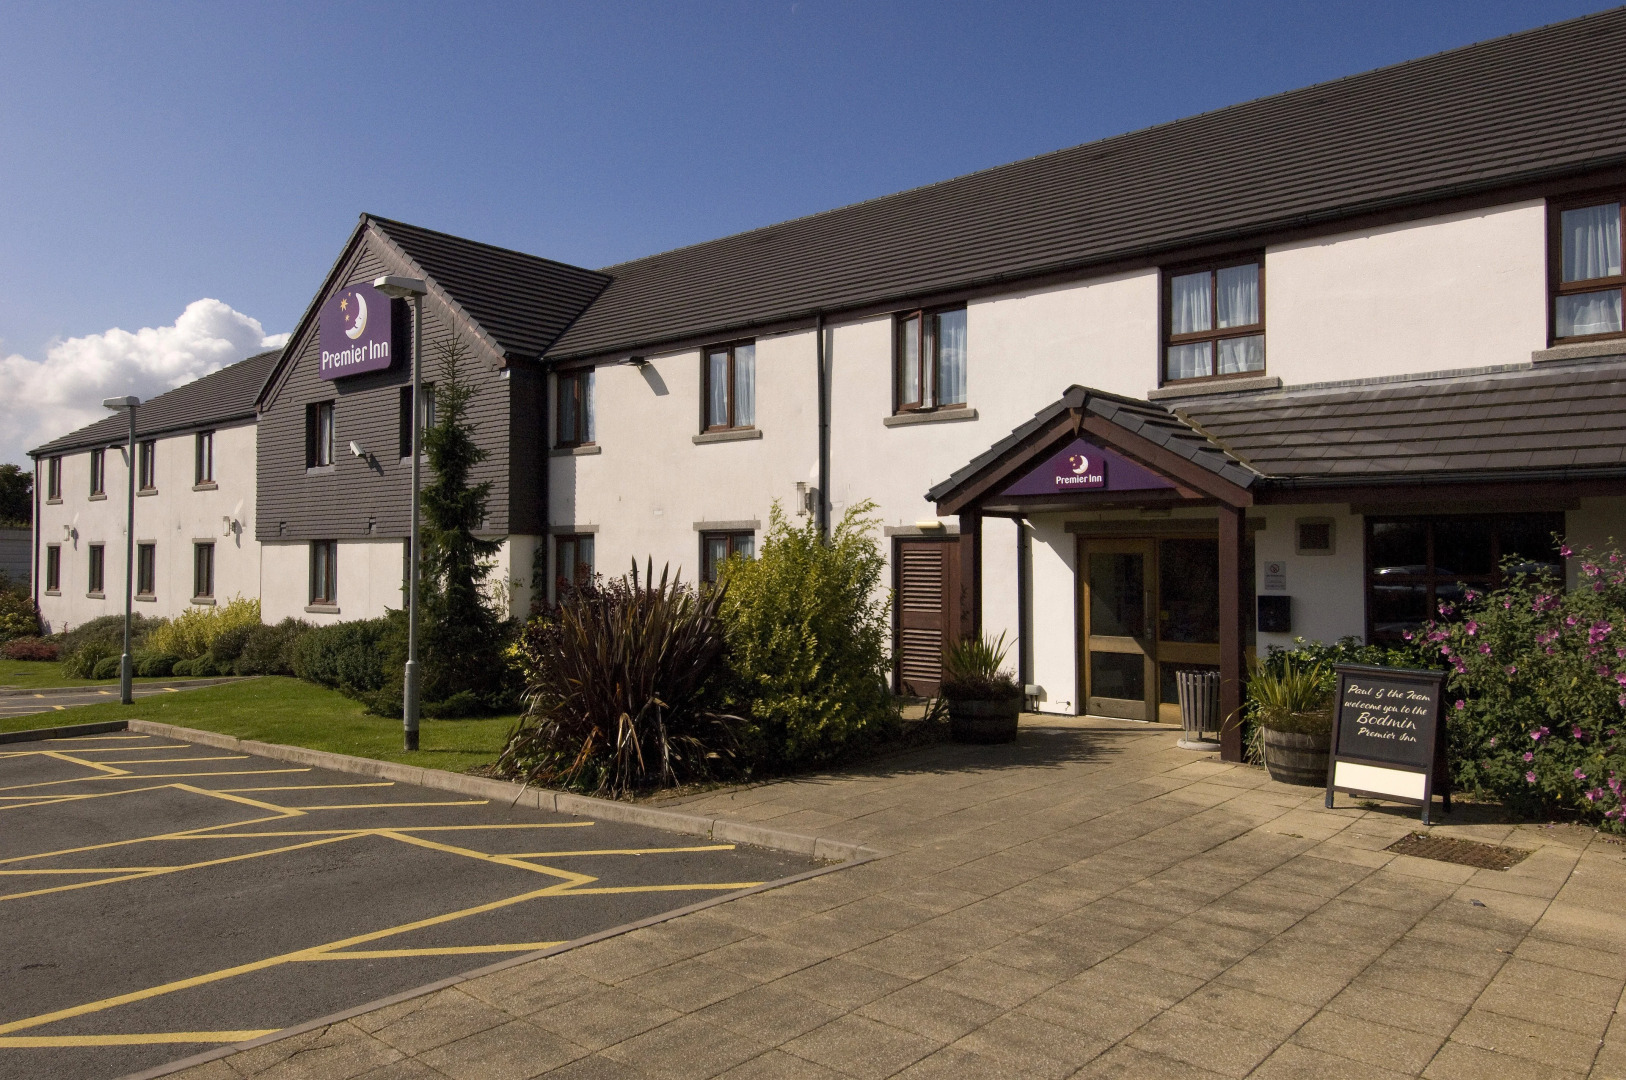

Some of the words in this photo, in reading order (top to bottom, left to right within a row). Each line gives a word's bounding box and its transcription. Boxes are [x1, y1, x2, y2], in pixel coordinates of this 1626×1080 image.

[322, 344, 368, 371] Premier
[369, 339, 389, 360] Inn
[1056, 475, 1088, 485] Premier
[1089, 474, 1102, 483] Inn
[1347, 684, 1373, 696] Paul
[1375, 688, 1385, 699] &
[1387, 689, 1404, 699] the
[1406, 690, 1431, 702] Team
[1344, 700, 1382, 711] welcome
[1383, 705, 1398, 714] you
[1400, 705, 1411, 714] to
[1411, 706, 1428, 716] the
[1356, 711, 1417, 730] Bodmin
[1357, 727, 1396, 740] Premier
[1399, 732, 1417, 743] Inn
